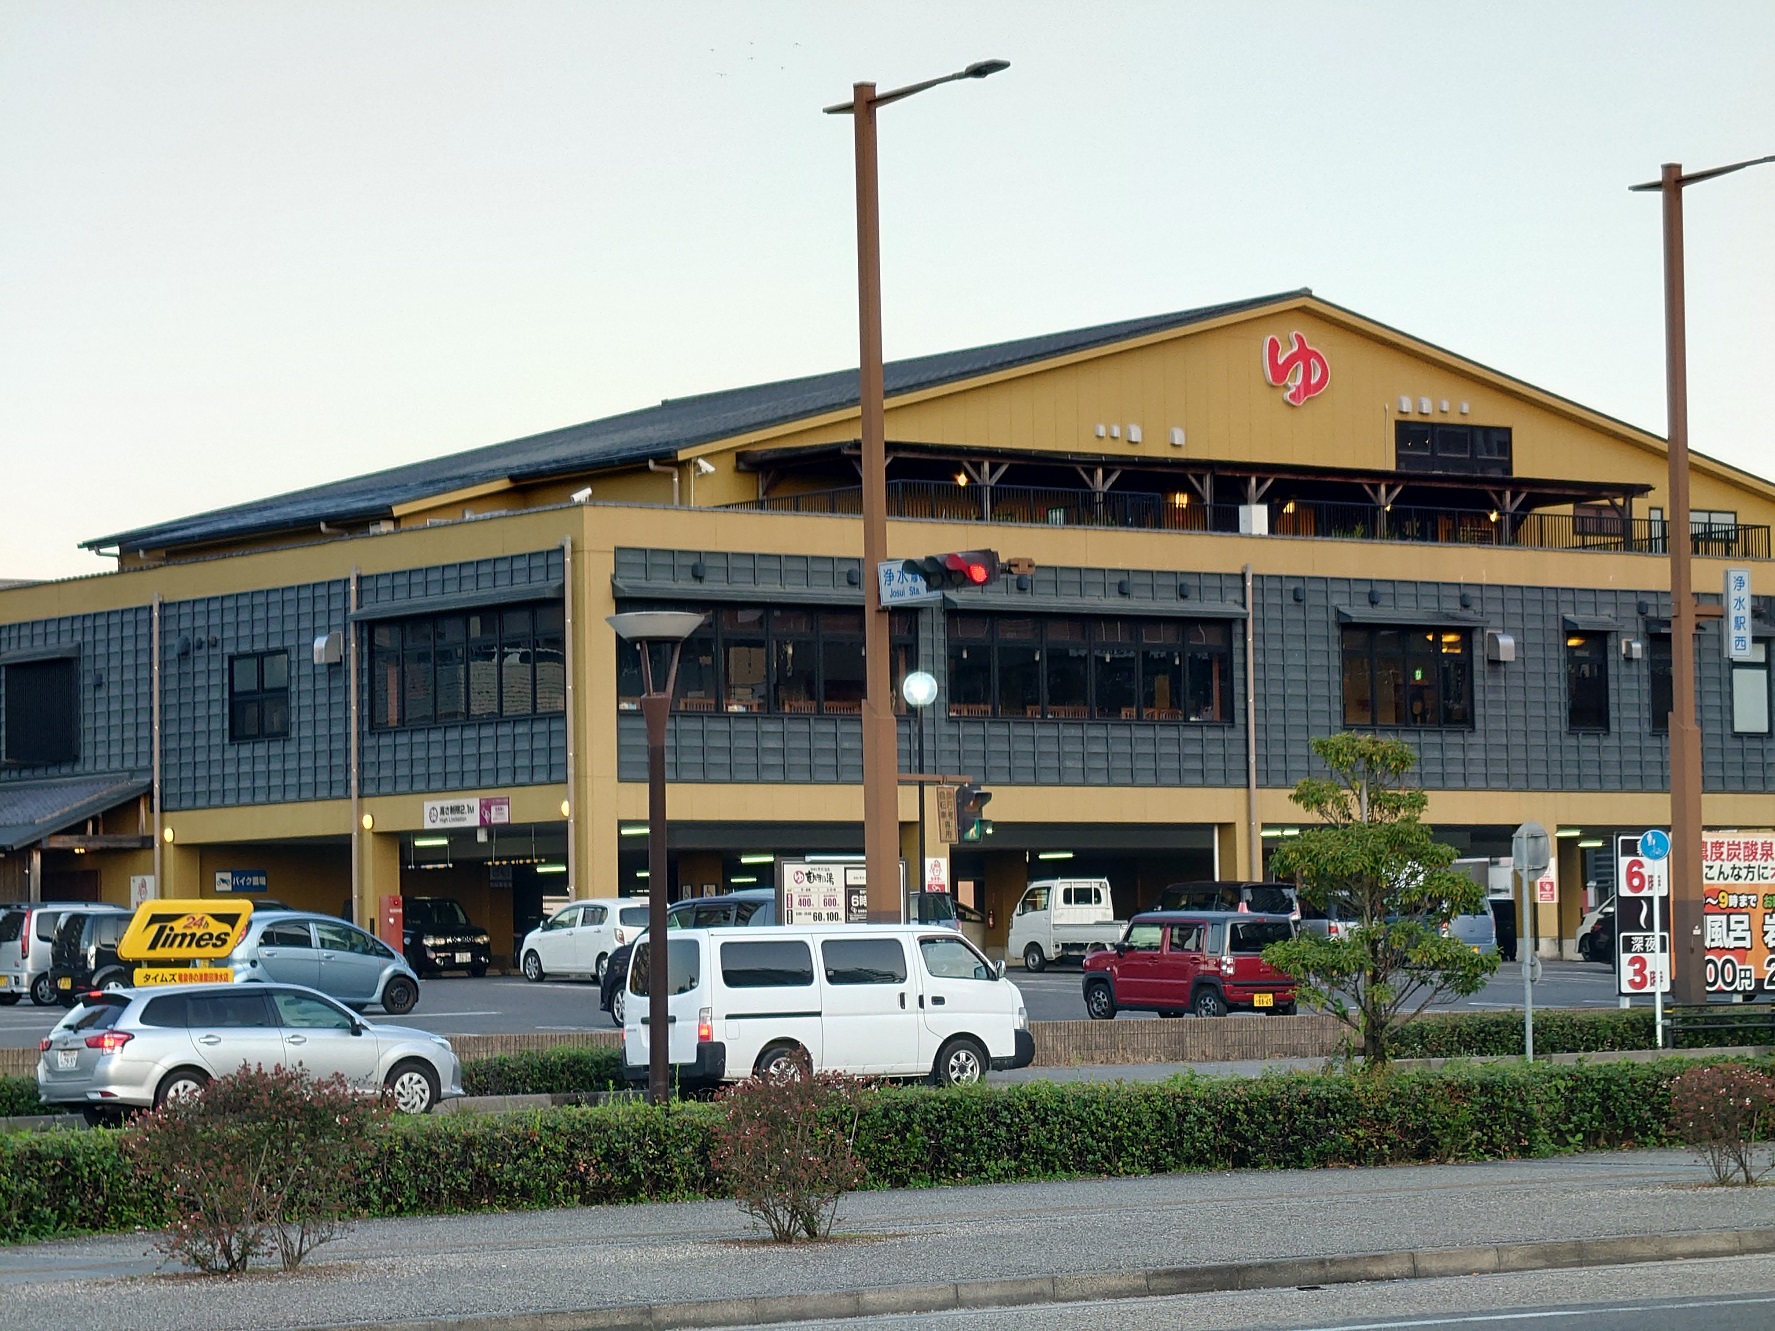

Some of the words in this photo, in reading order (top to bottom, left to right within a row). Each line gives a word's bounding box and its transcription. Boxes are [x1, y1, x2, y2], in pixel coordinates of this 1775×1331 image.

[1263, 331, 1330, 406] ゆ
[889, 587, 906, 599] Josui
[1733, 575, 1747, 651] 浄水駅西
[146, 924, 231, 951] Times
[1631, 936, 1656, 952] 深夜
[1703, 914, 1752, 949] 風呂
[143, 973, 177, 983] タイムズ
